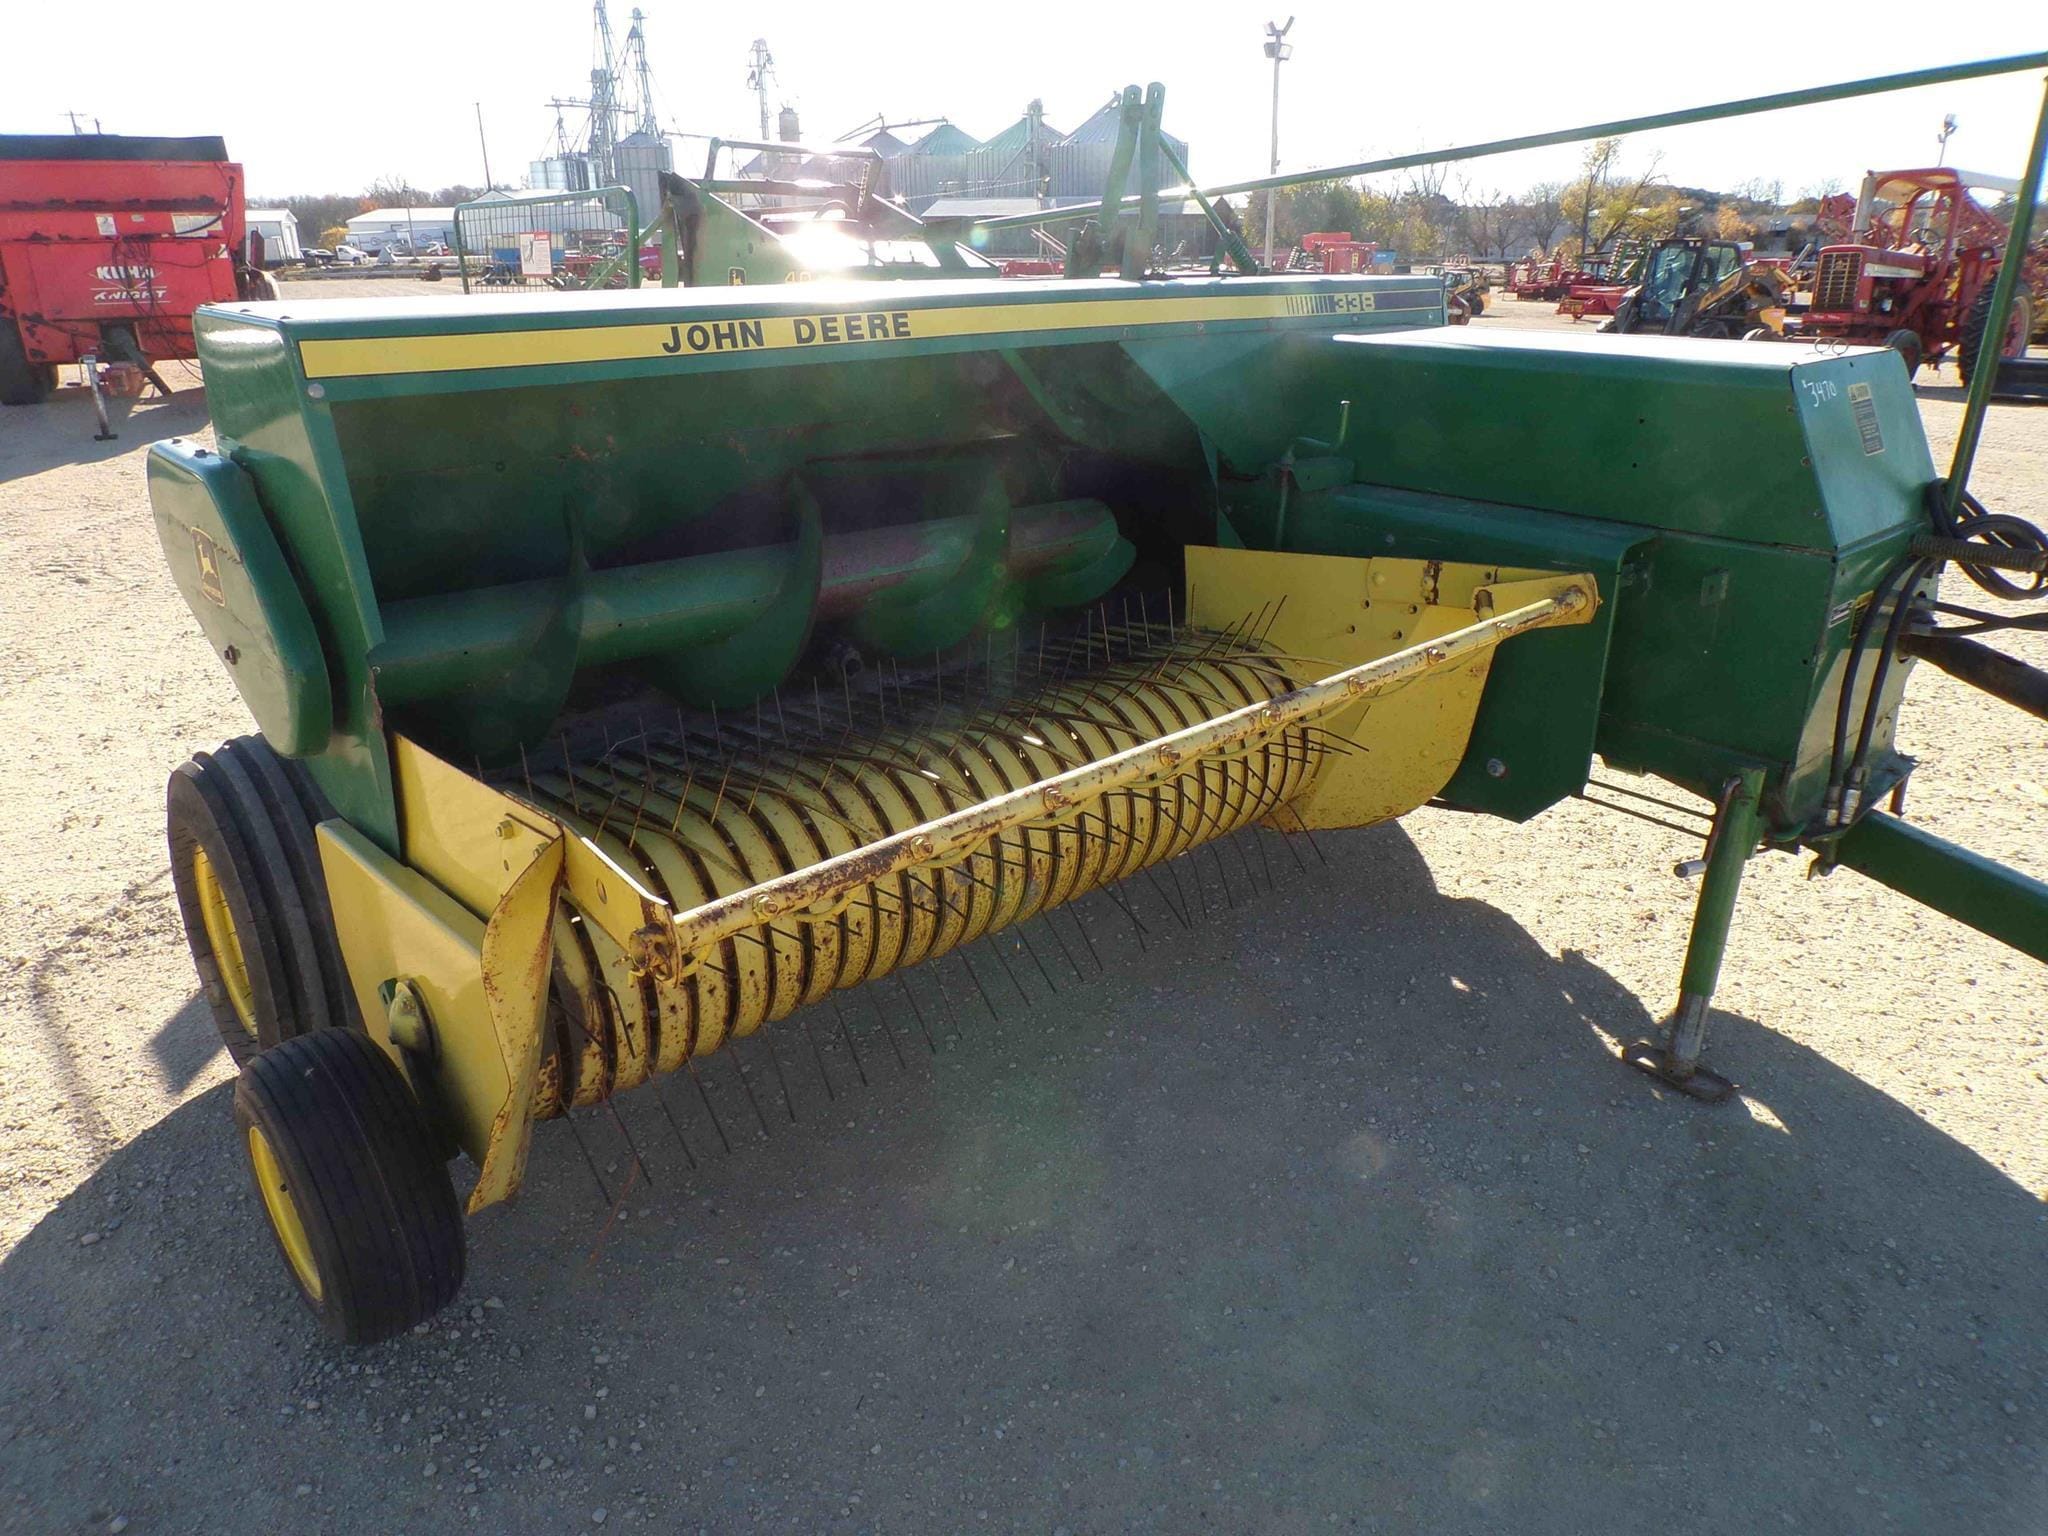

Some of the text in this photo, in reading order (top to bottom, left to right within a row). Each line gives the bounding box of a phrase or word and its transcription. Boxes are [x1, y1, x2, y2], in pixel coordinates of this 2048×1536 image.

[1334, 292, 1376, 314] 338
[662, 312, 912, 354] JOHN DEERE
